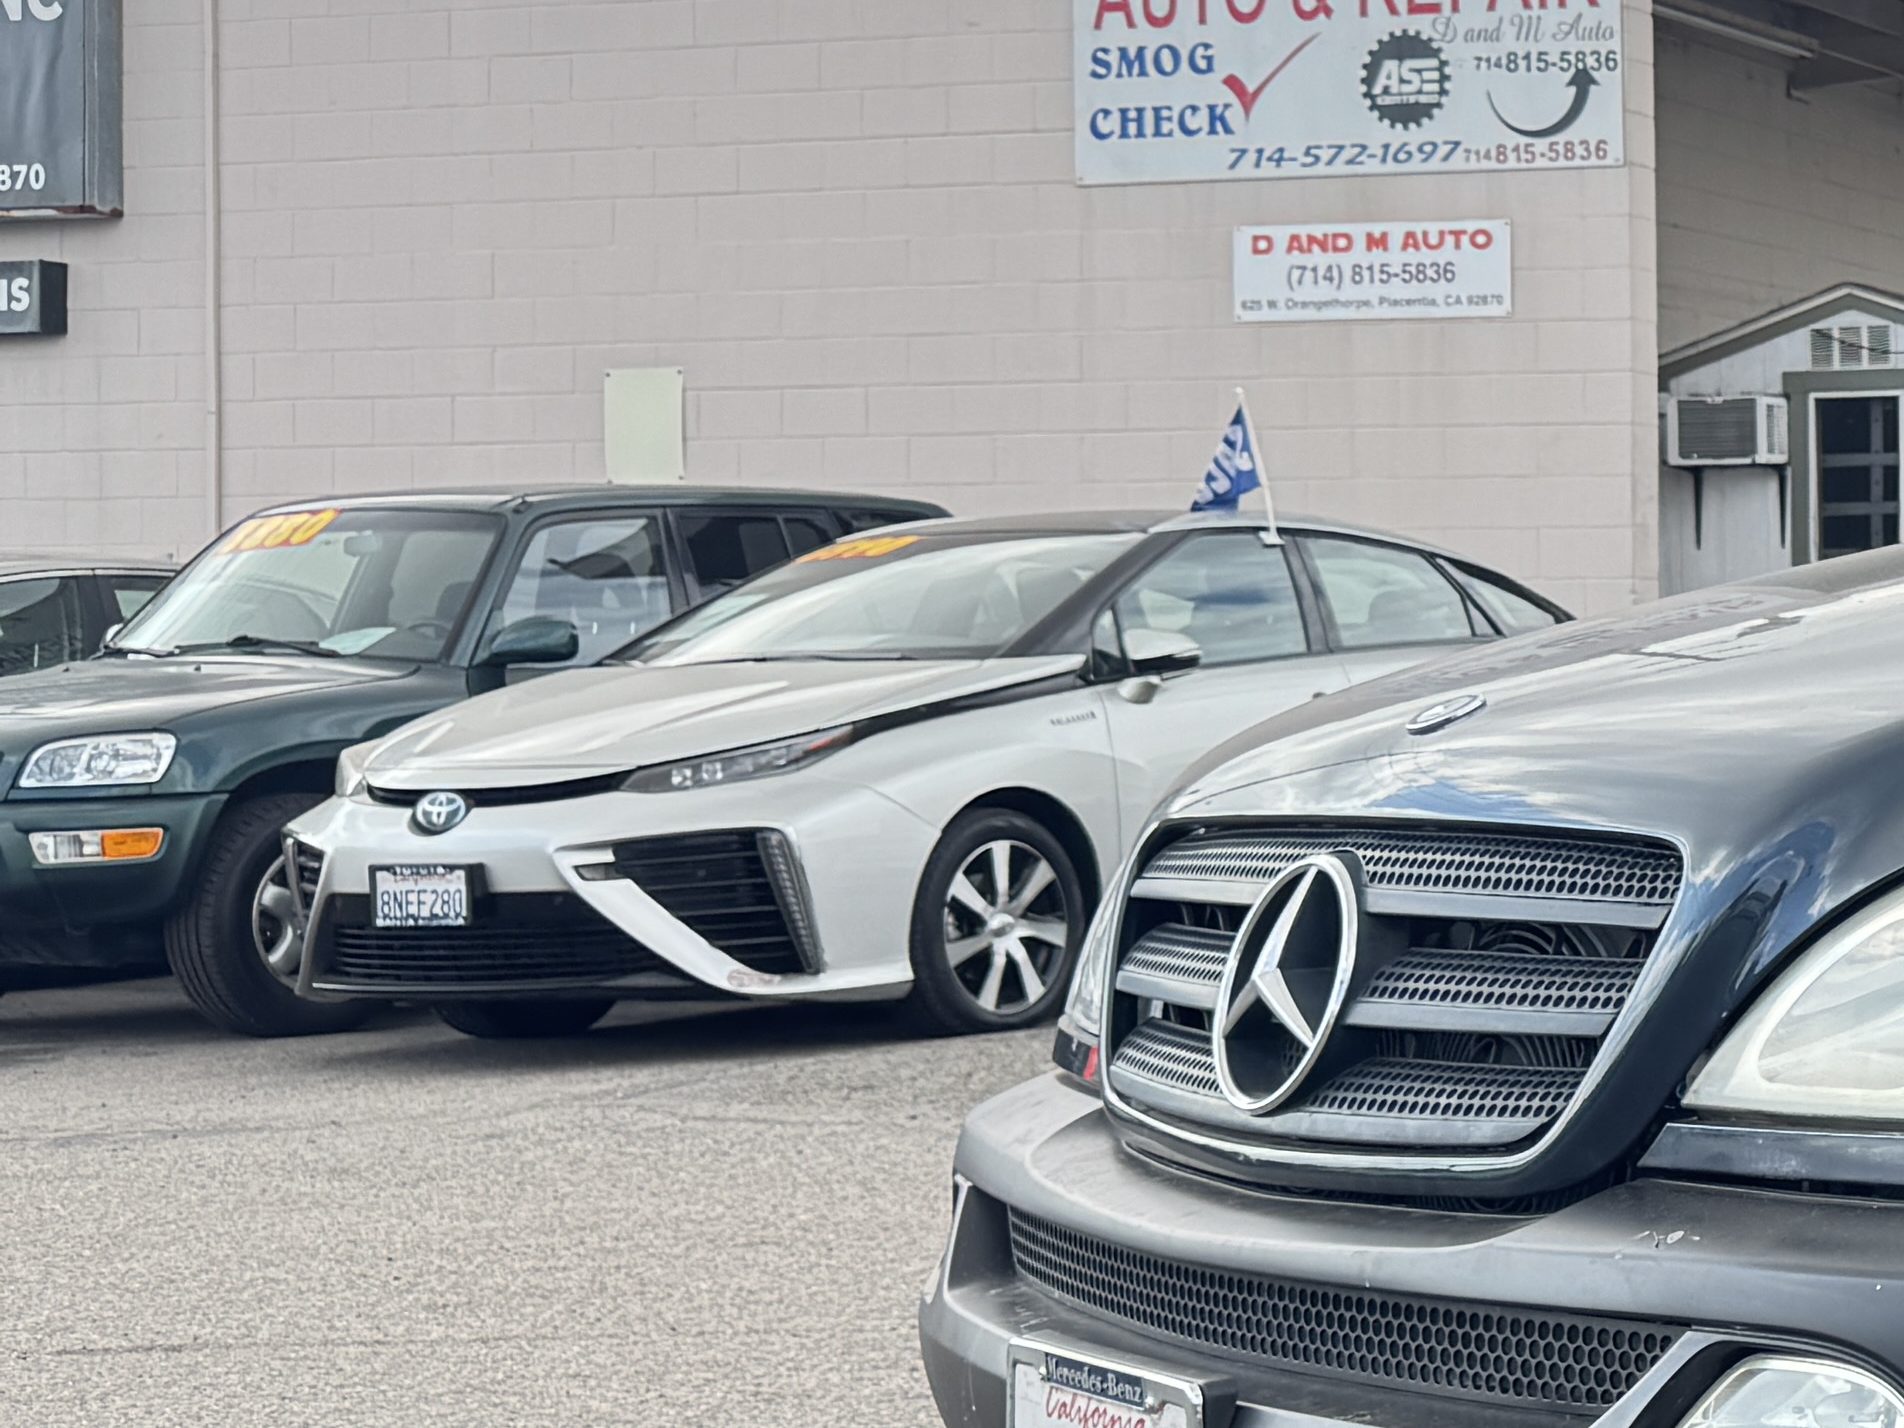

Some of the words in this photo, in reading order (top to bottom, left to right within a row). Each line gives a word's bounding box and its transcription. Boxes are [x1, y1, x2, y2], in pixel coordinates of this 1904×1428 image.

[1463, 15, 1501, 44] and
[1551, 12, 1615, 42] Auto
[1089, 42, 1215, 80] SMOG
[1372, 58, 1440, 95] ASE
[1089, 103, 1235, 140] CHECK
[1227, 139, 1463, 171] 714-572-1697
[1251, 234, 1274, 255] D
[1285, 233, 1354, 255] AND
[1365, 231, 1389, 253] M
[1400, 229, 1493, 252] AUTO
[1287, 264, 1343, 291] (714)
[1351, 261, 1456, 285] 815-5836
[1444, 294, 1463, 307] CA
[1046, 1353, 1144, 1404] Mercedes-Benz
